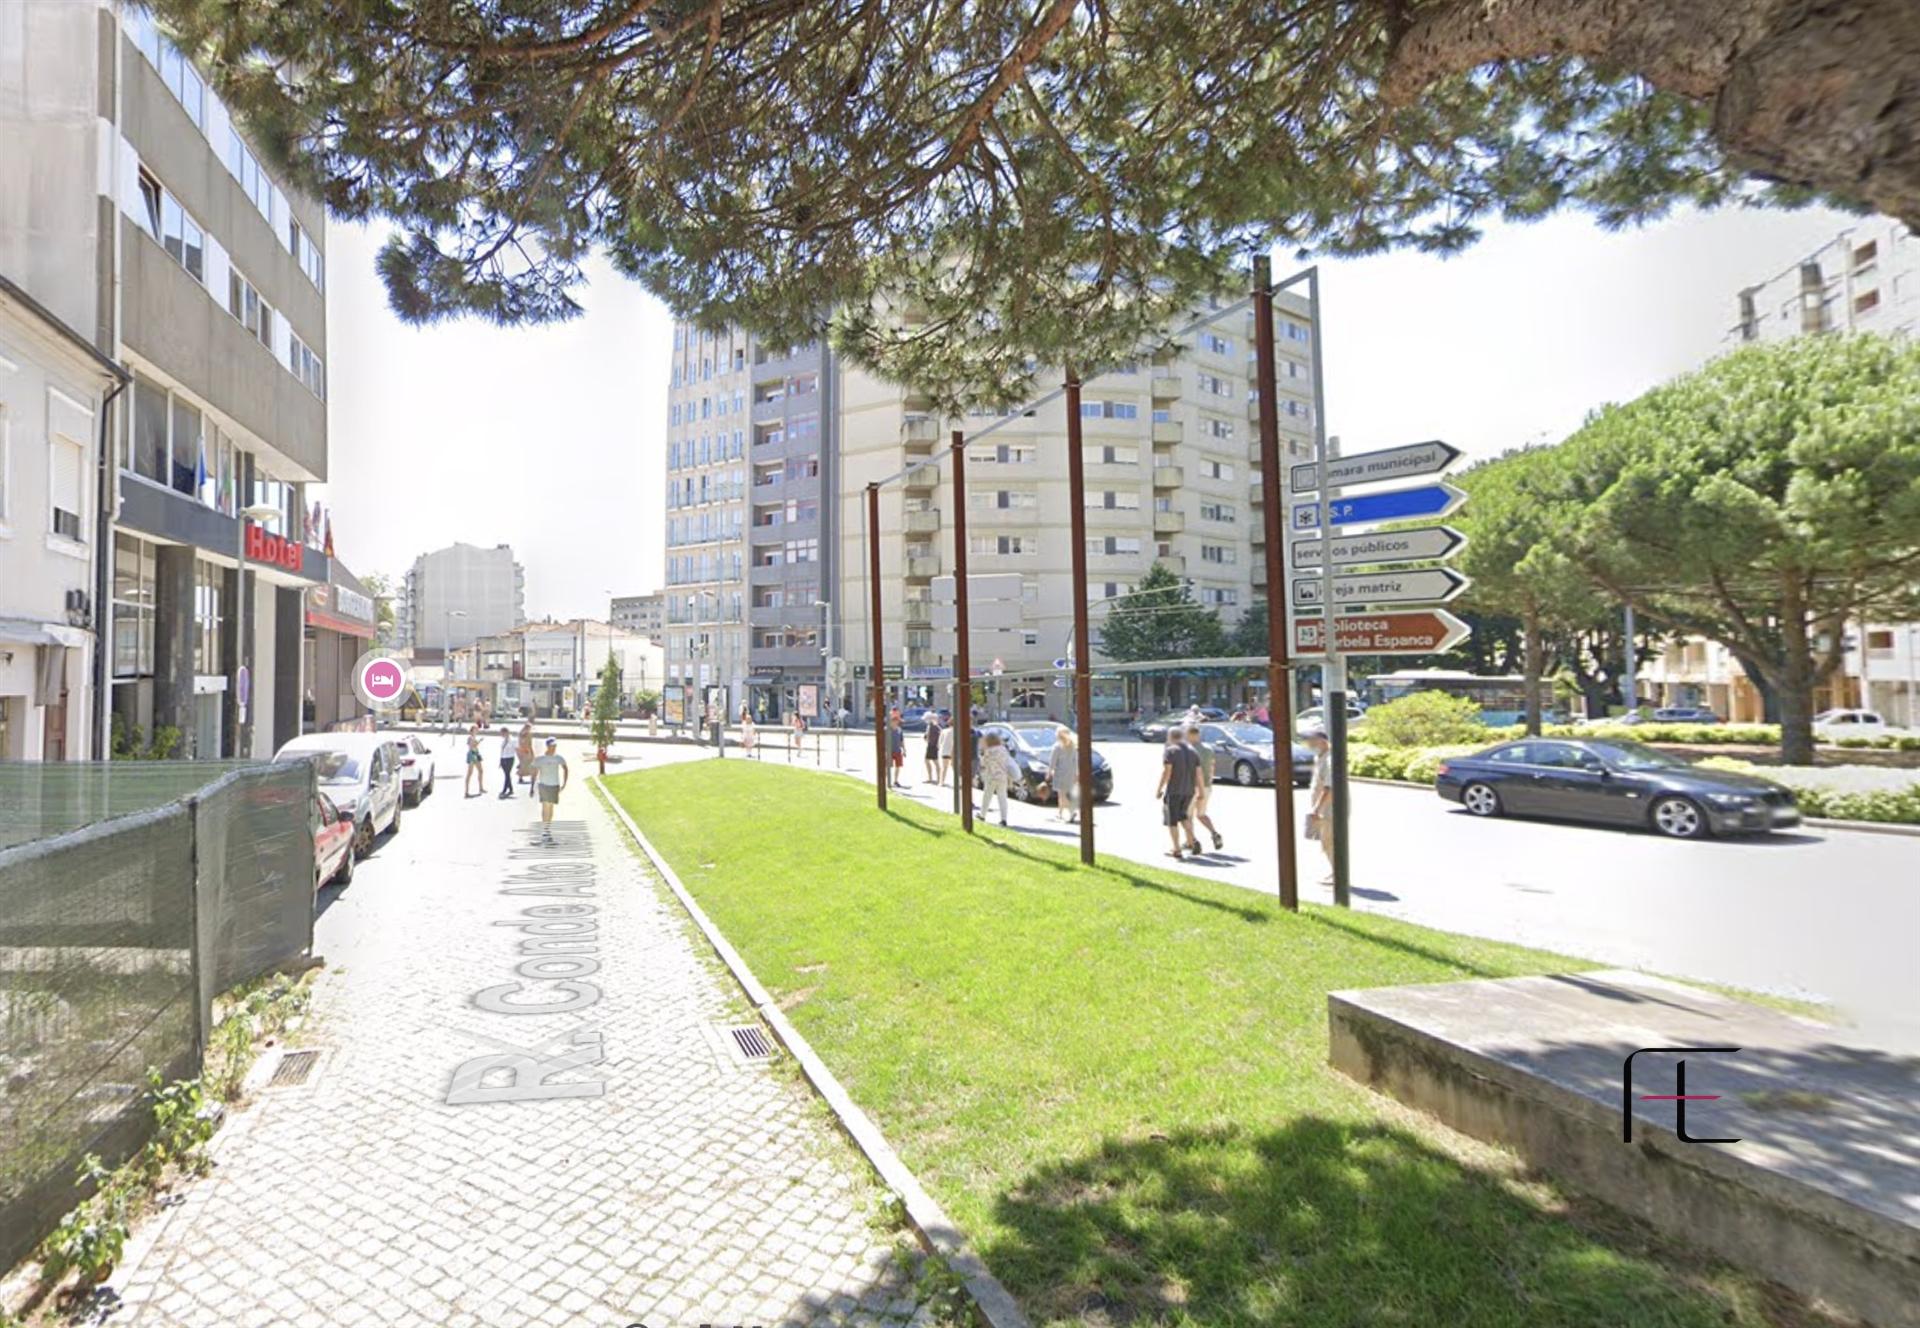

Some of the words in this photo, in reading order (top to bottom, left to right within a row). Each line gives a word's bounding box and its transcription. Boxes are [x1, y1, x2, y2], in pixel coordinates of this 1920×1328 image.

[1320, 464, 1364, 480] mara
[1368, 451, 1436, 473] municipal
[244, 523, 304, 573] Hotel
[1297, 546, 1348, 559] servos
[1319, 583, 1354, 597] ieja
[1358, 581, 1402, 593] matriz
[1375, 634, 1433, 649] Espanca
